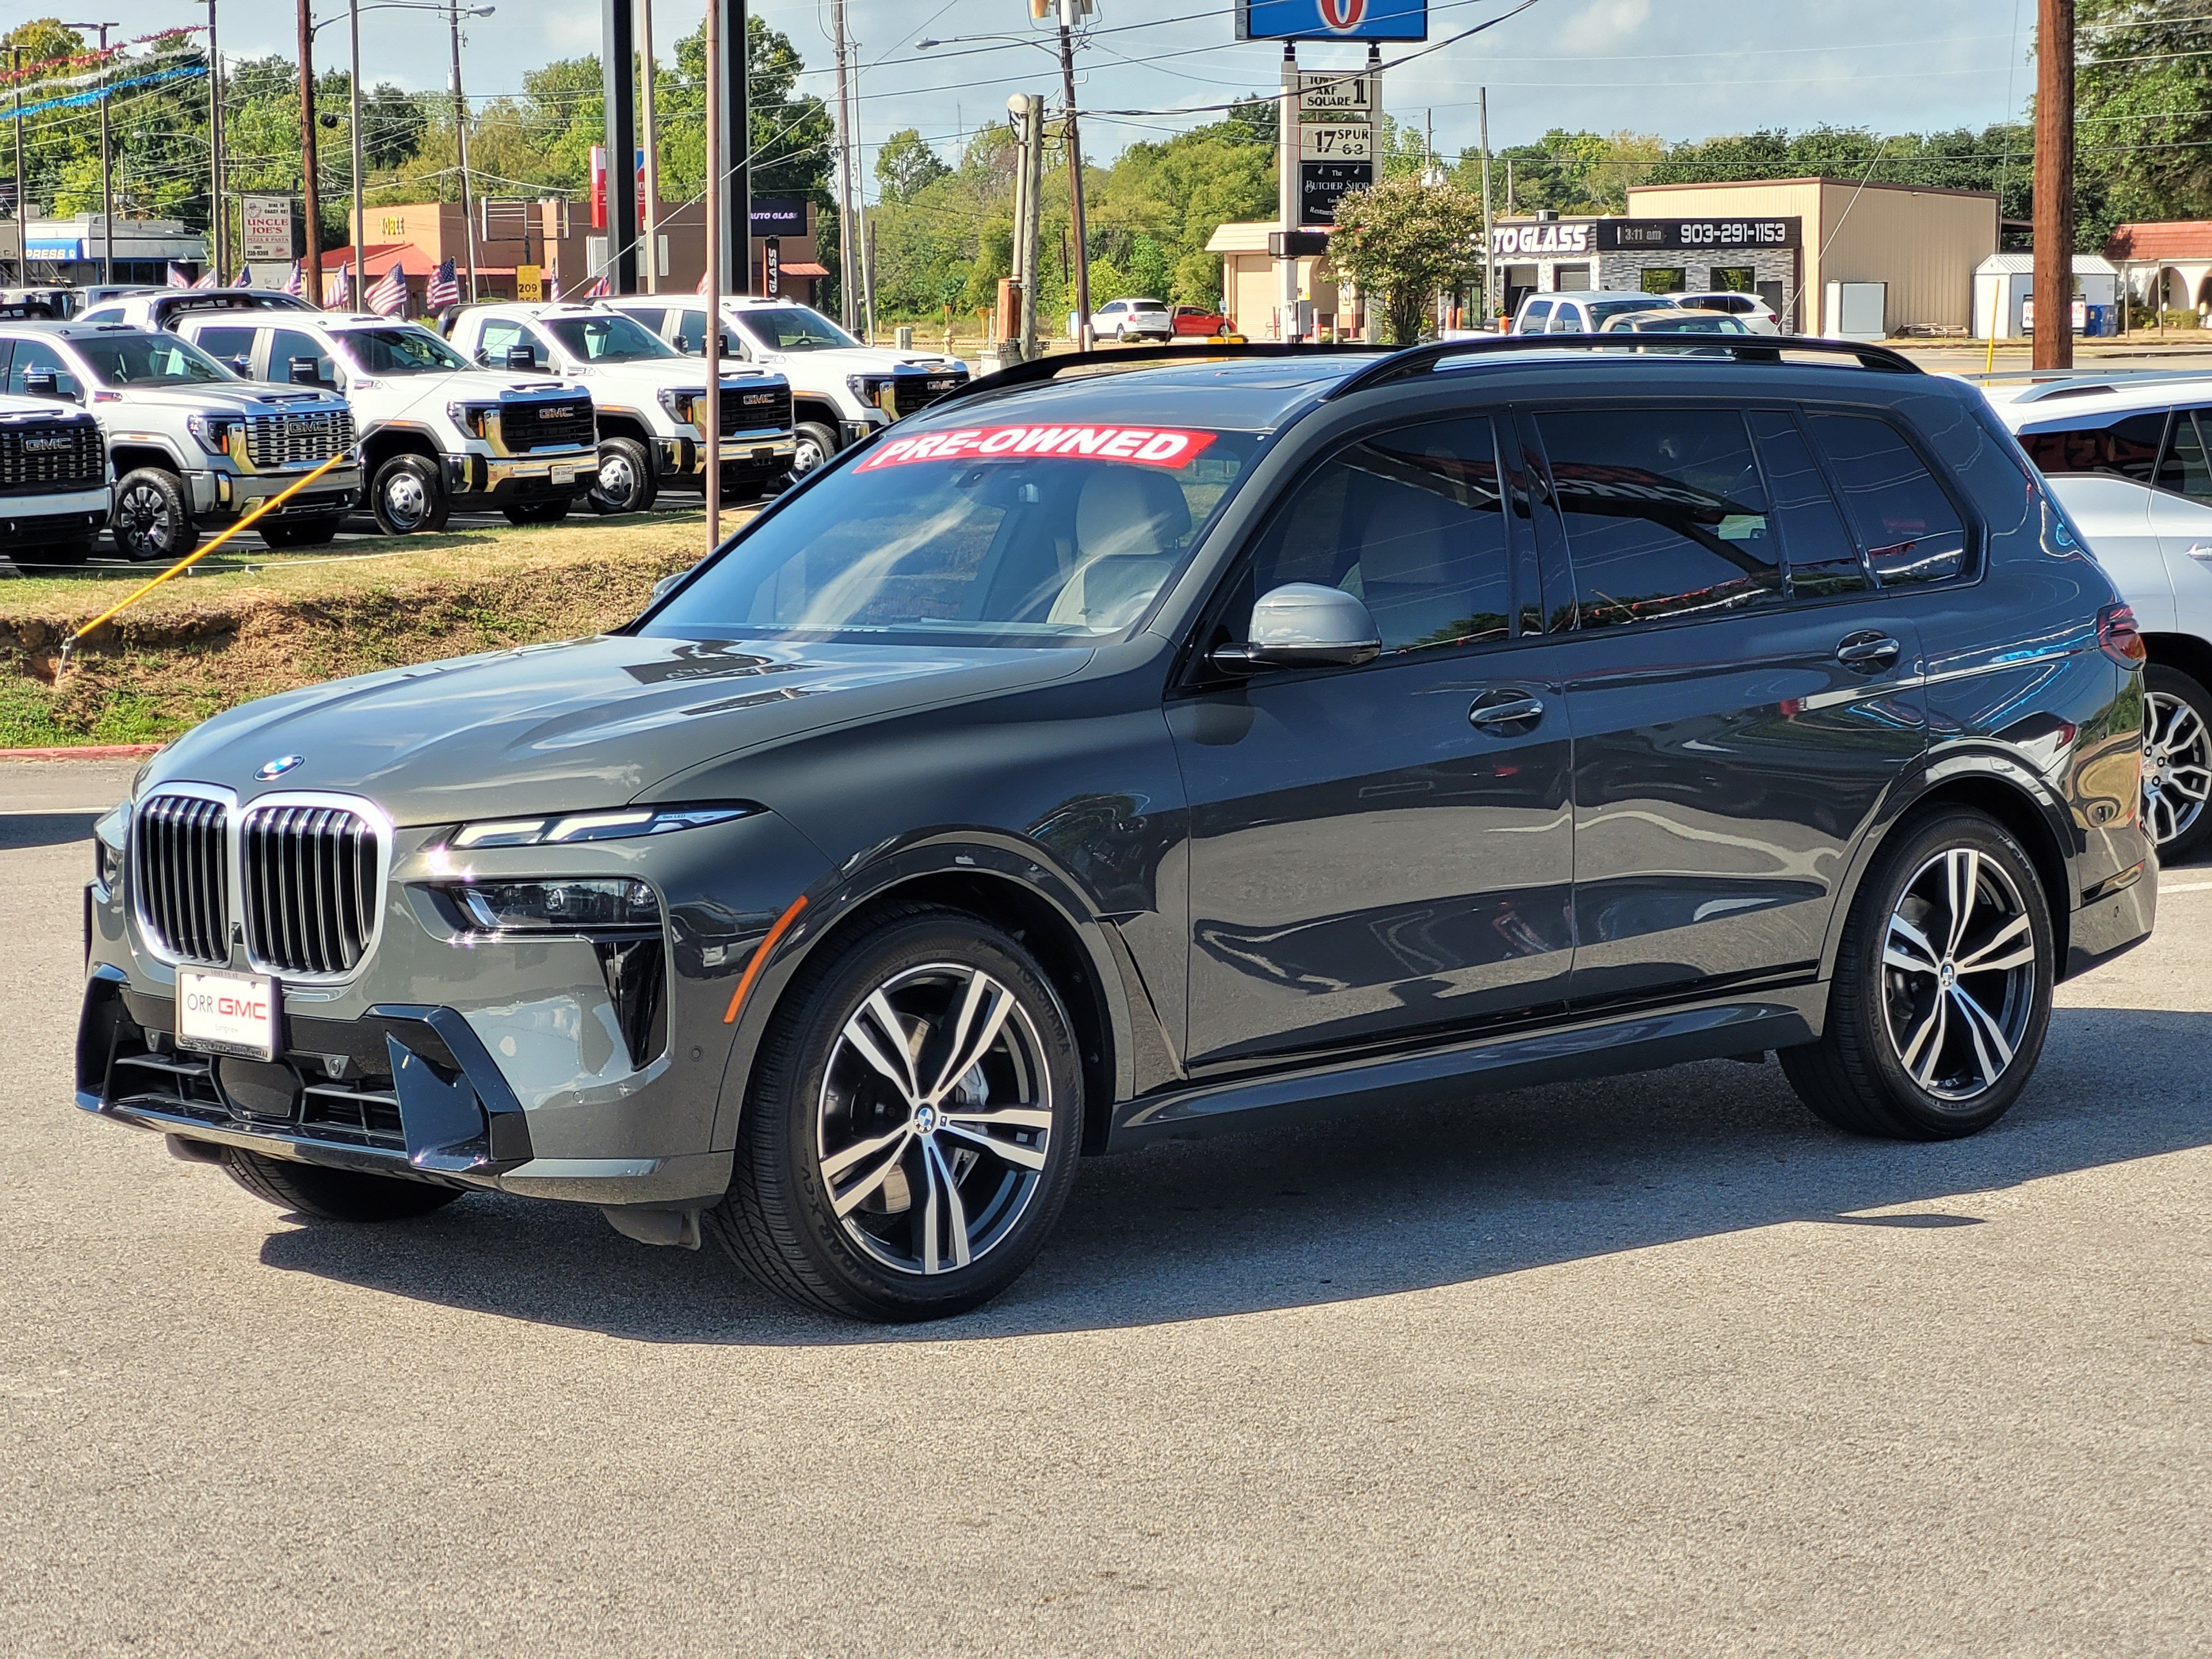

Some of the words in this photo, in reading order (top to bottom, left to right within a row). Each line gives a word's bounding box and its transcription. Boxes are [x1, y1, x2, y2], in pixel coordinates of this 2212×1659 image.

[1310, 76, 1344, 84] TOW
[1307, 97, 1351, 106] SQUARE
[1338, 129, 1369, 139] SPUR
[1342, 144, 1363, 155] 63
[1305, 180, 1343, 193] BUTCHER
[1646, 229, 1662, 240] am
[1680, 223, 1786, 244] 903-291-1153
[769, 247, 777, 294] GLASS
[518, 283, 537, 293] 209
[927, 380, 955, 390] GMC
[743, 393, 775, 405] GMC
[539, 407, 574, 419] GMC
[289, 420, 329, 433] GMC
[26, 437, 72, 452] GMC
[869, 428, 1188, 468] PRE-OWNED
[187, 993, 213, 1014] ORR
[218, 997, 267, 1021] GMC
